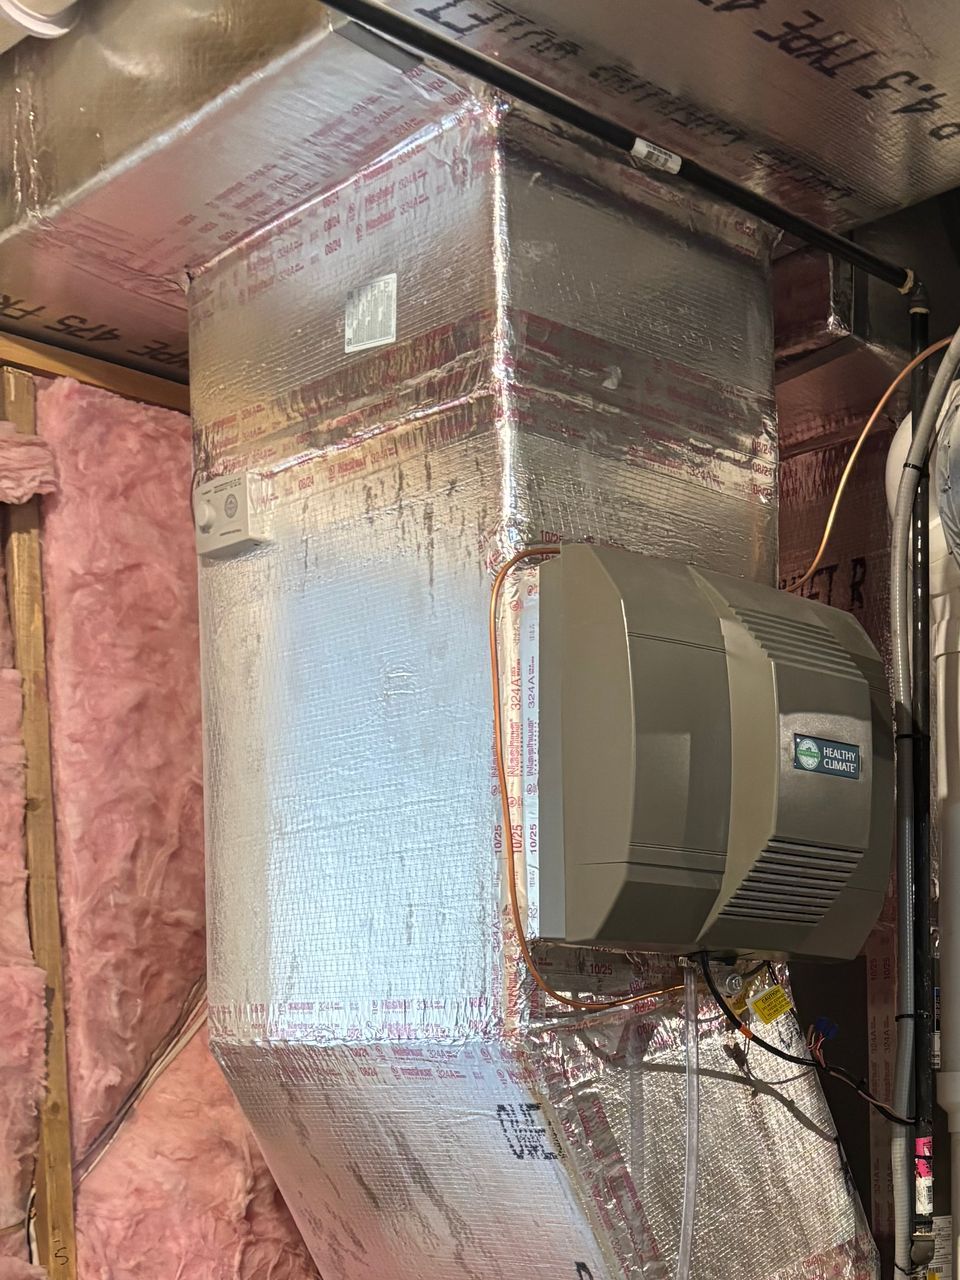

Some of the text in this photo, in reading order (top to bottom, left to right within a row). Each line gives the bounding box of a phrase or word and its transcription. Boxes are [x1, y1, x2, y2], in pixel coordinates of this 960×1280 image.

[44, 314, 121, 342] 475
[511, 676, 521, 711] 324A
[823, 746, 856, 762] HEALTHY
[590, 963, 613, 976] 10/25
